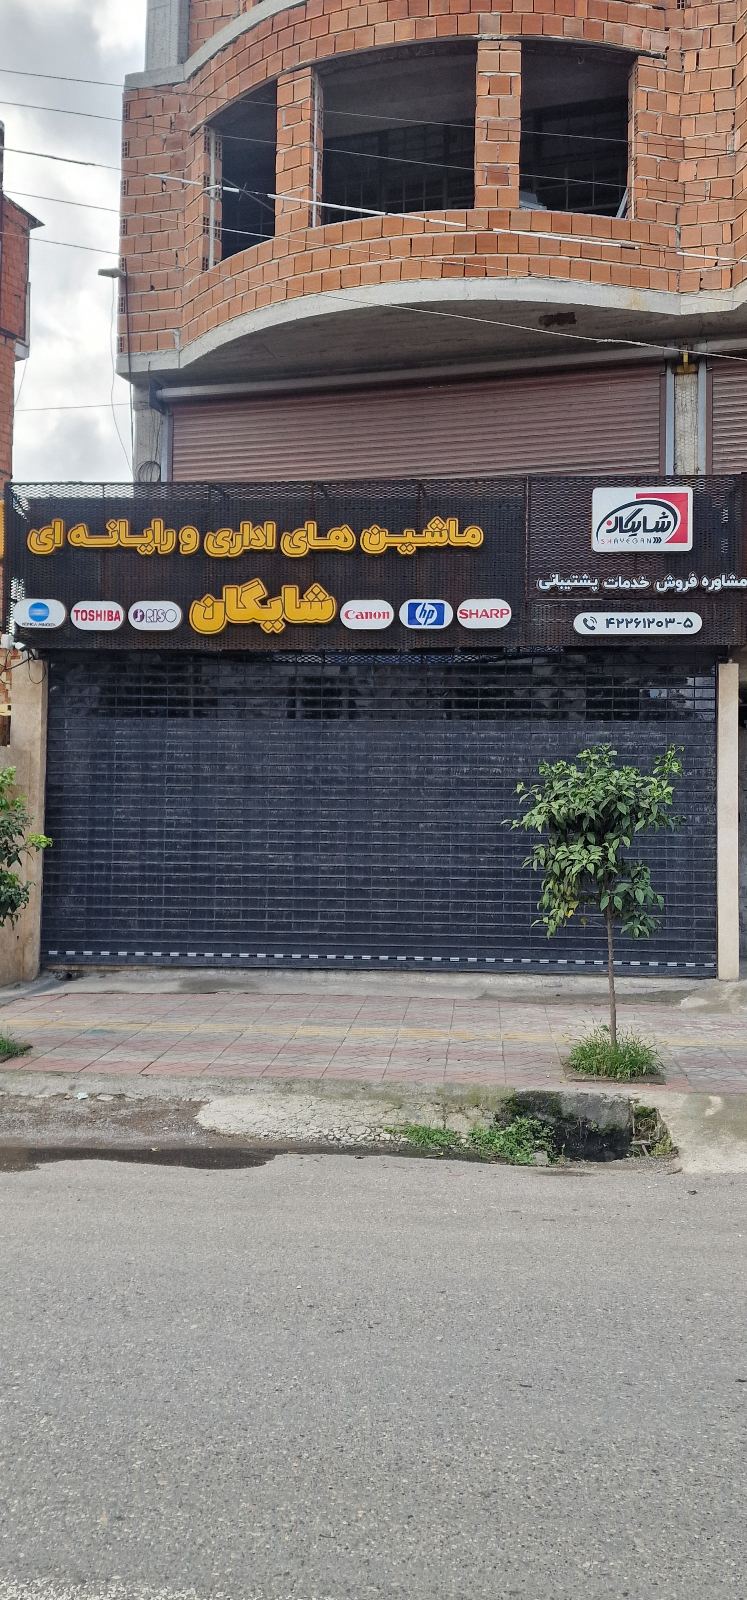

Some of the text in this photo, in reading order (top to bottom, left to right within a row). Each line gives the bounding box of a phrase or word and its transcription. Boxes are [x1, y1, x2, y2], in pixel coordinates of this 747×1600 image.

[606, 508, 671, 537] شایگان
[27, 516, 483, 558] ماشین های اداری و رایانه ای
[537, 571, 747, 592] مشاوره فروش خدمات پشتیبانی
[73, 609, 121, 622] TOSHIBA
[145, 609, 178, 623] RISO
[189, 578, 337, 635] شایگان
[344, 609, 391, 621] Canon
[418, 603, 435, 626] hp
[458, 608, 511, 620] SHARP
